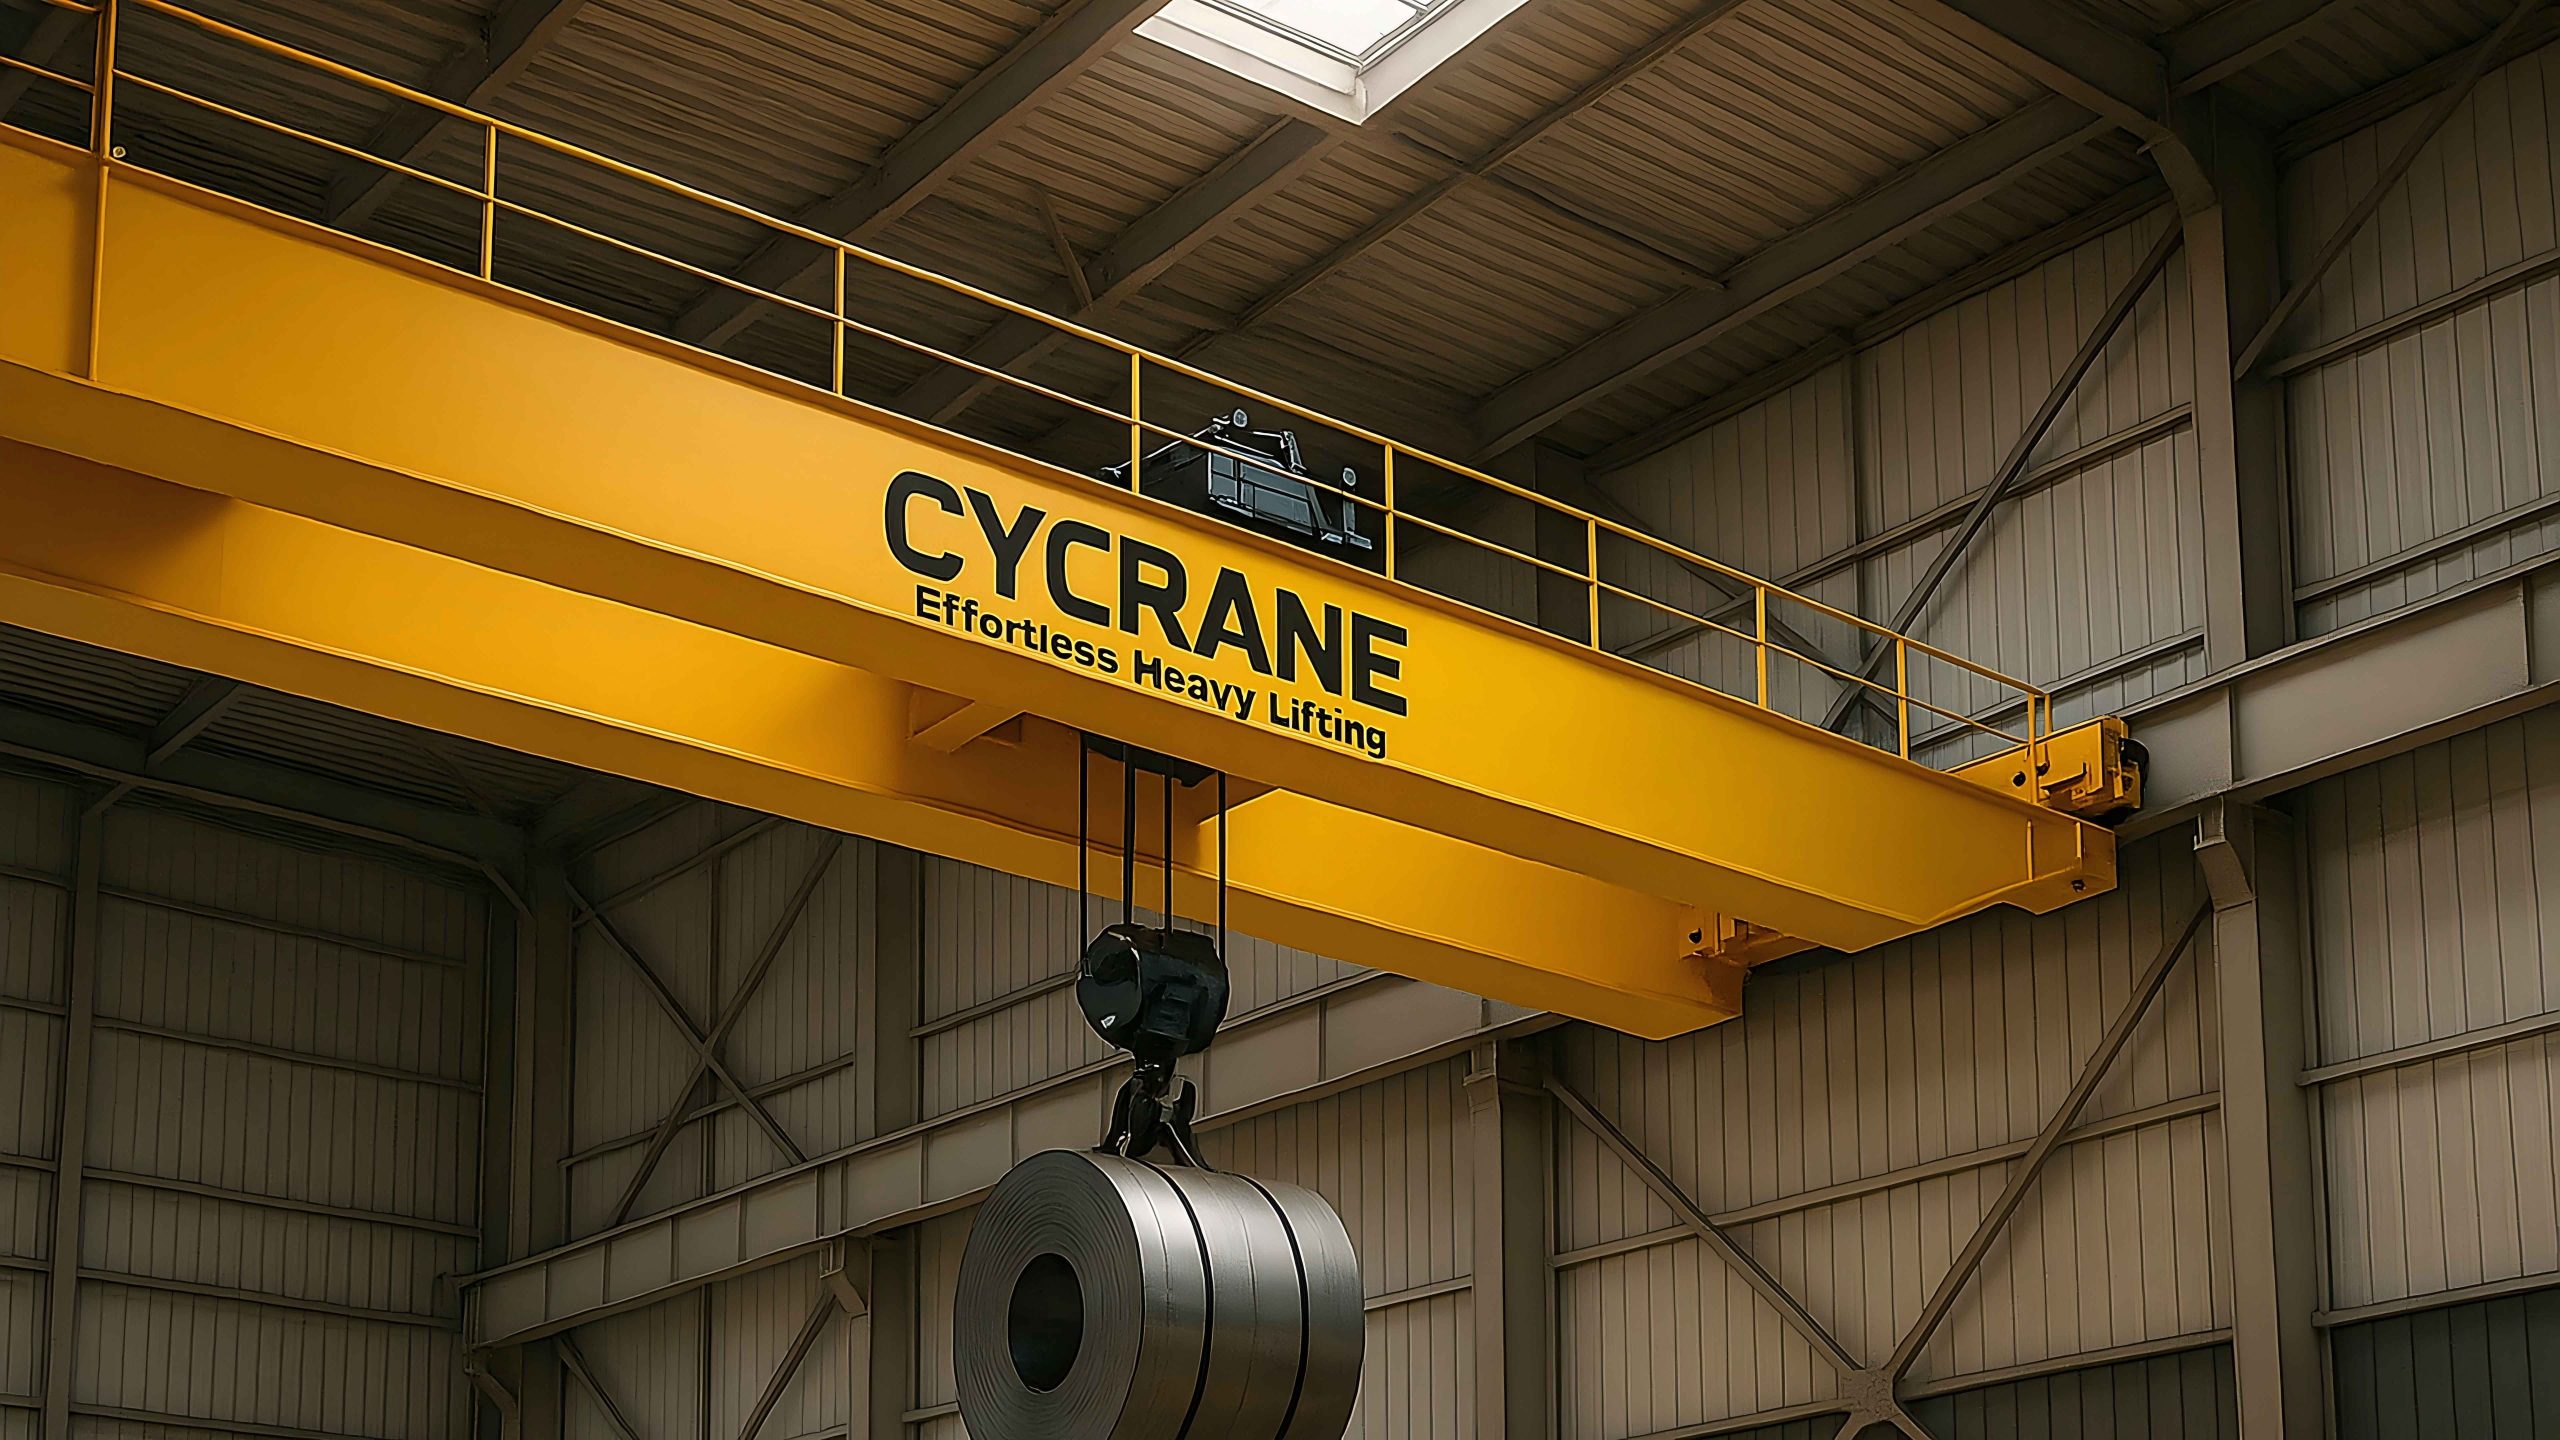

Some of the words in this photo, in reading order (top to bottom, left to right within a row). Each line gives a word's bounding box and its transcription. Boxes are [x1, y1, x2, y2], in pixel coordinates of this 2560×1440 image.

[884, 471, 1408, 717] CYCRANE
[916, 584, 1119, 674] Effortless
[1134, 649, 1257, 721] Heavy
[1269, 691, 1386, 759] Lifting
